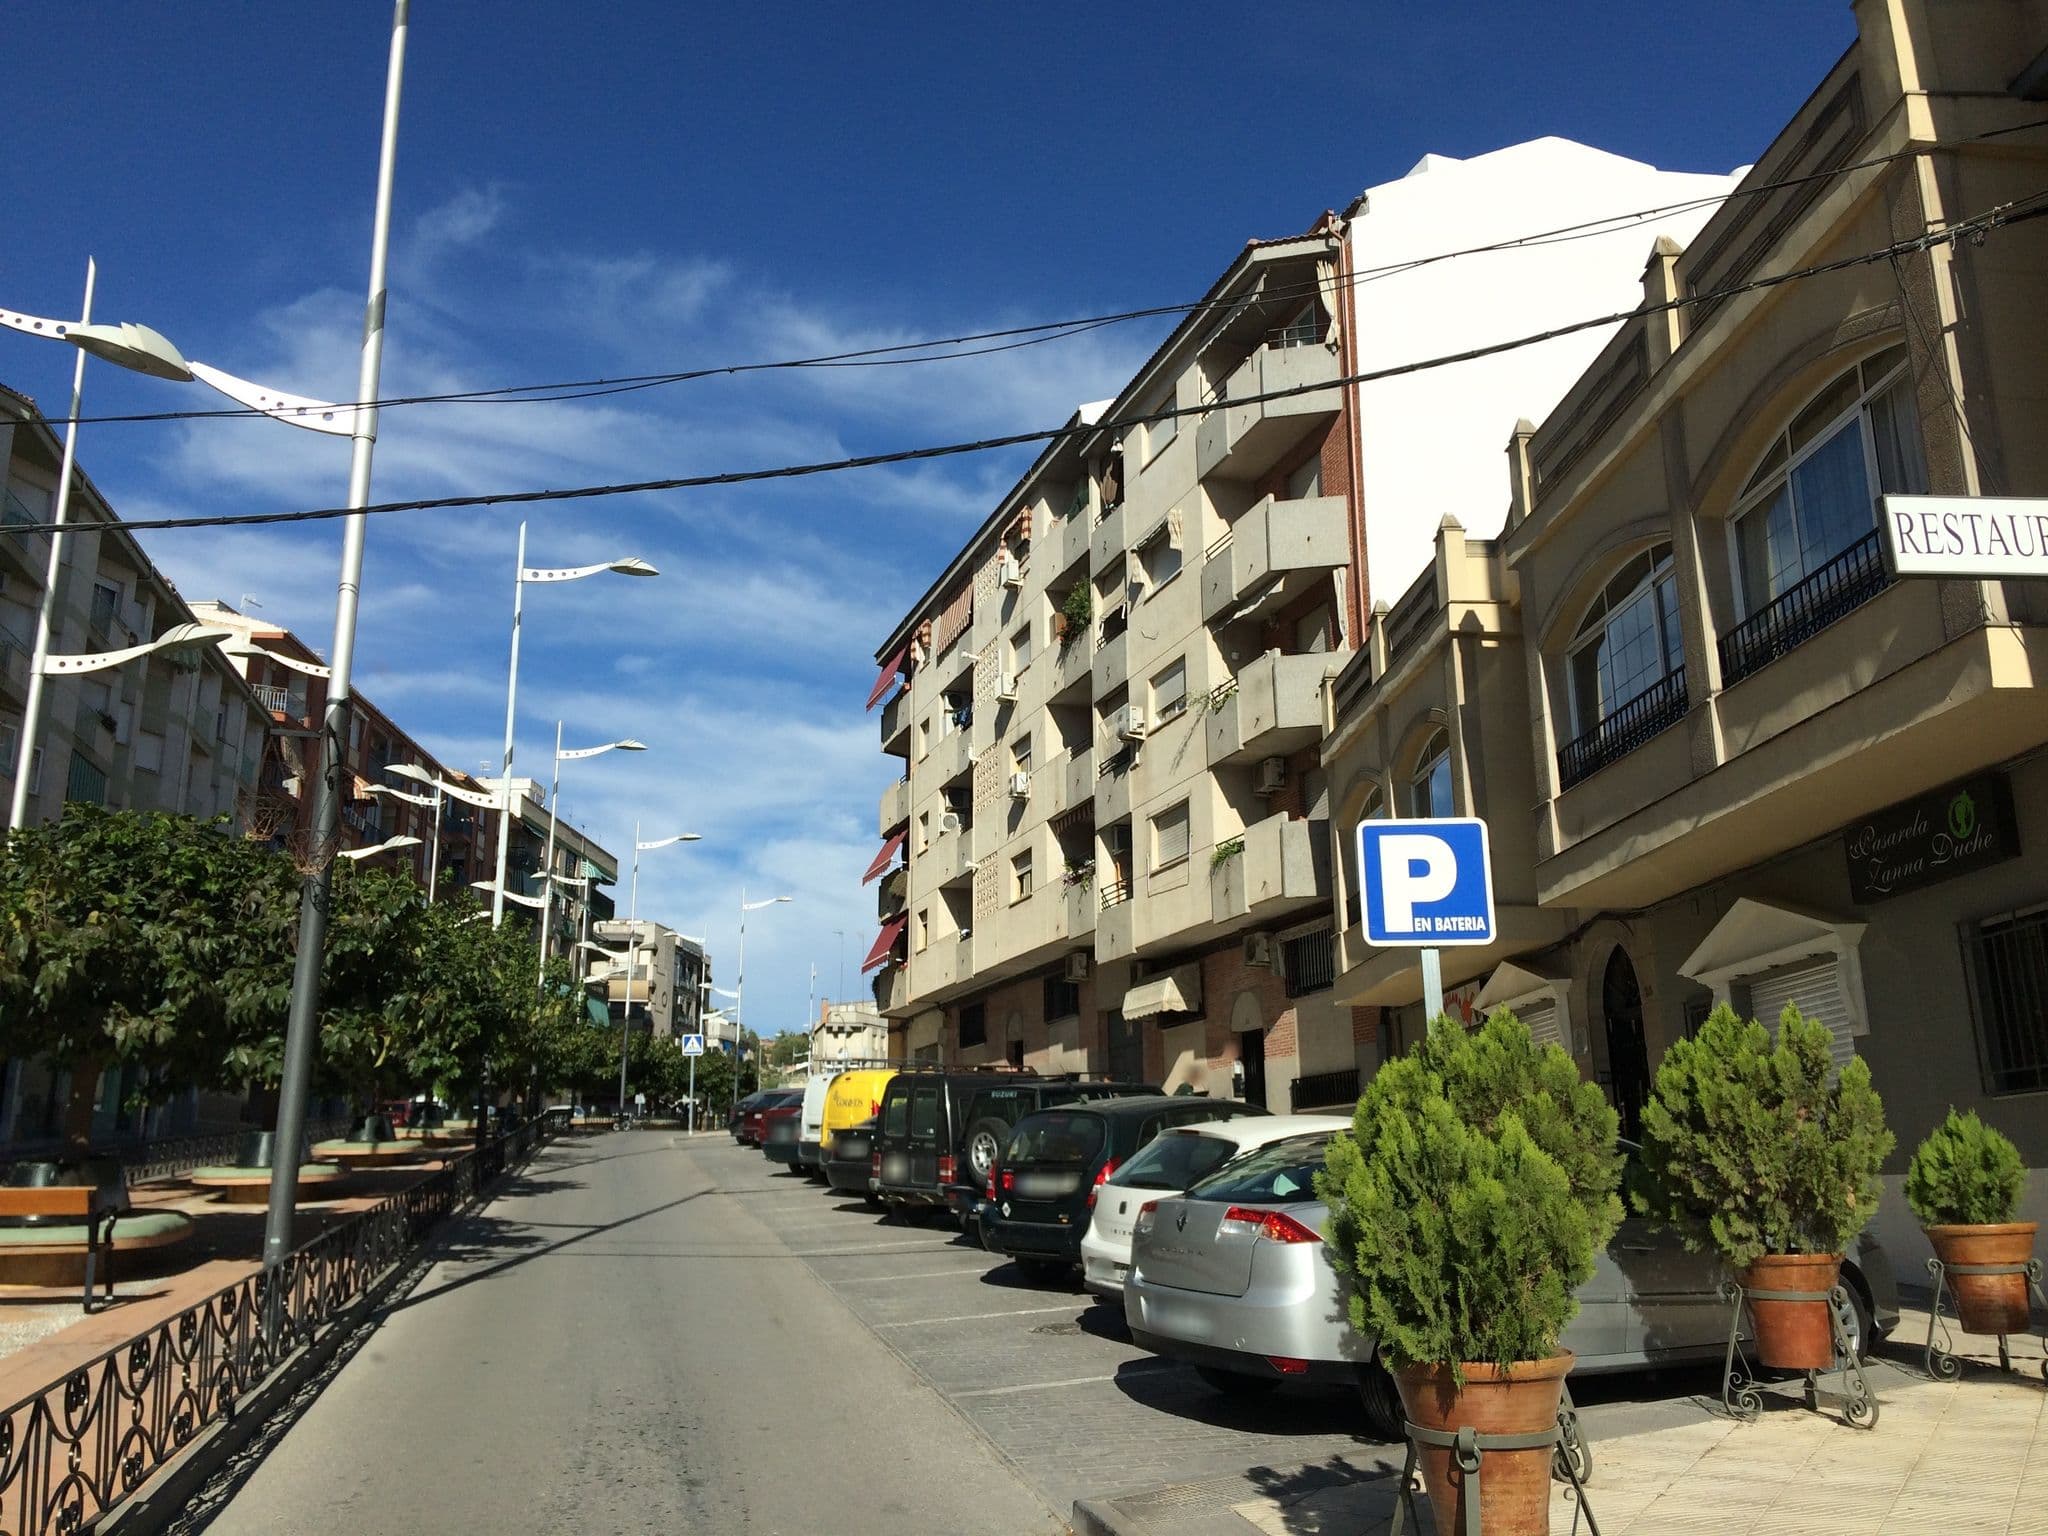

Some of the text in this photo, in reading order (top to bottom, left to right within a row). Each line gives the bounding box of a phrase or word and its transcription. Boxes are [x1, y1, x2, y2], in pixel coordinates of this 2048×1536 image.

[1379, 834, 1457, 932] P
[1413, 916, 1486, 932] EN BATERIA
